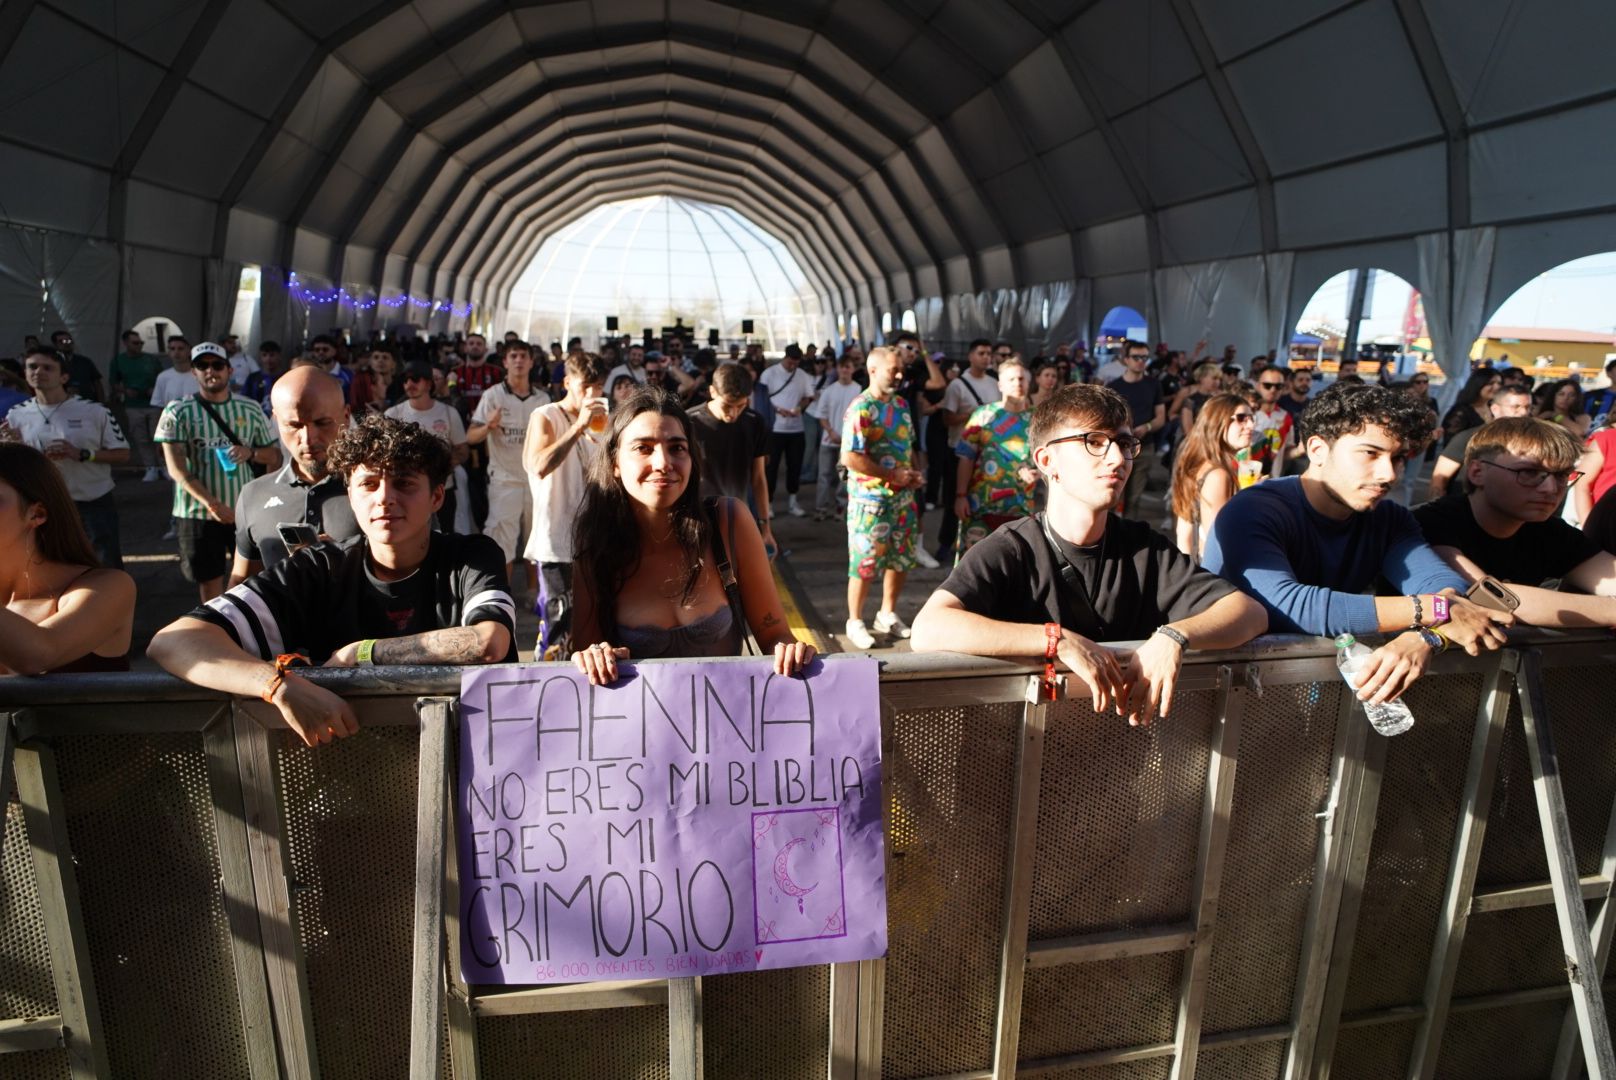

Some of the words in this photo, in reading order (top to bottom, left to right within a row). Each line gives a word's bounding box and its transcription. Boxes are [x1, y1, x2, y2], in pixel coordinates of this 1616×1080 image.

[487, 671, 815, 766] FAENNA
[469, 772, 526, 824] NO
[546, 763, 644, 815] ERES
[669, 761, 710, 806] MI
[729, 756, 864, 807] BLIBLIA
[471, 822, 568, 880] ERES
[608, 817, 656, 865] MI
[467, 860, 734, 968] GRIMORIO
[536, 965, 556, 981] 86
[561, 963, 590, 978] 000
[596, 958, 655, 976] OYENTES
[666, 956, 698, 972] BIEN
